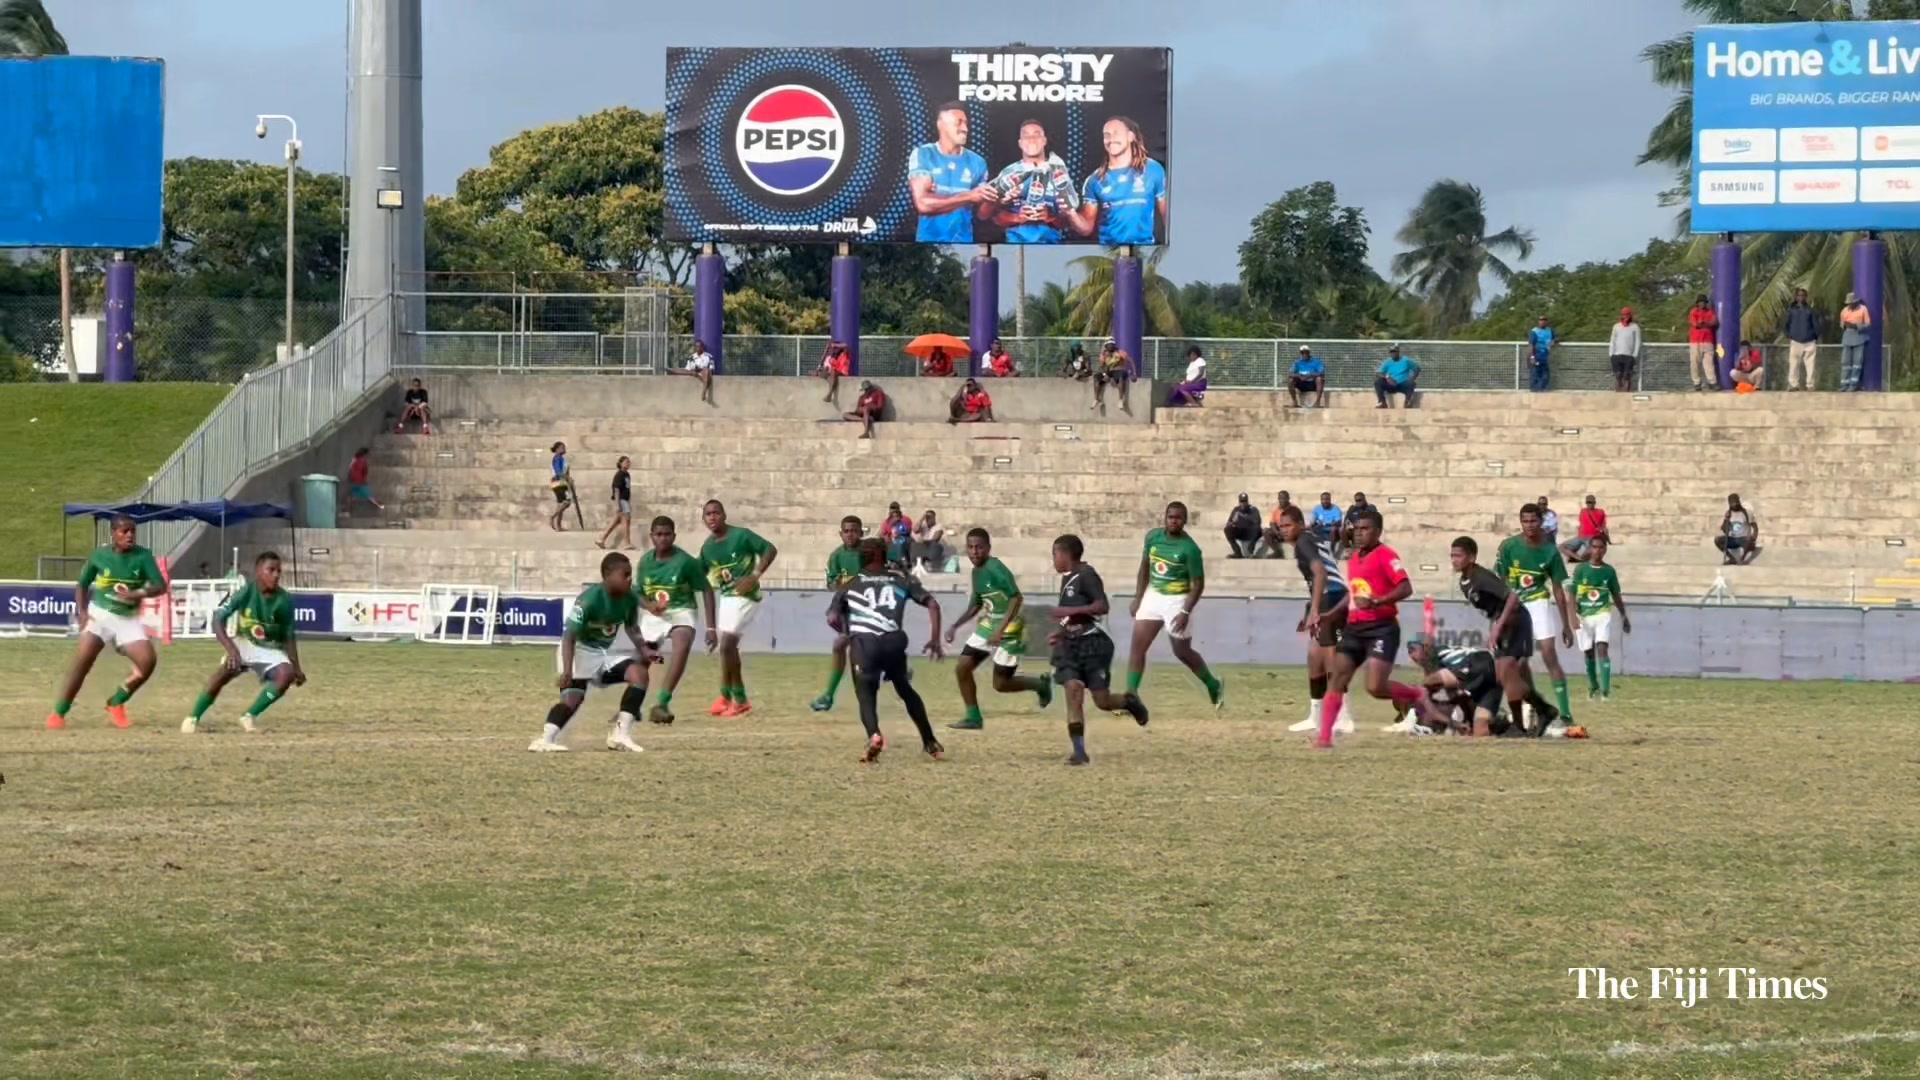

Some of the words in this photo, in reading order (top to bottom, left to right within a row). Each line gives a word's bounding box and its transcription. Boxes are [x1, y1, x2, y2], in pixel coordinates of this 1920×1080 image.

[951, 53, 1114, 82] THIRSTY
[1707, 41, 1824, 78] Home
[1828, 39, 1863, 76] &
[958, 84, 1017, 102] FOR
[1020, 84, 1104, 102] MORE
[1750, 94, 1773, 106] BIG
[1776, 92, 1836, 106] BRANDS,
[1838, 91, 1889, 105] BIGGER
[743, 128, 837, 151] PEPSI
[1710, 182, 1765, 192] SAMSUNG
[1886, 179, 1913, 190] TCL
[823, 221, 859, 233] DRUA
[863, 585, 897, 610] 14
[474, 606, 547, 627] Sadium
